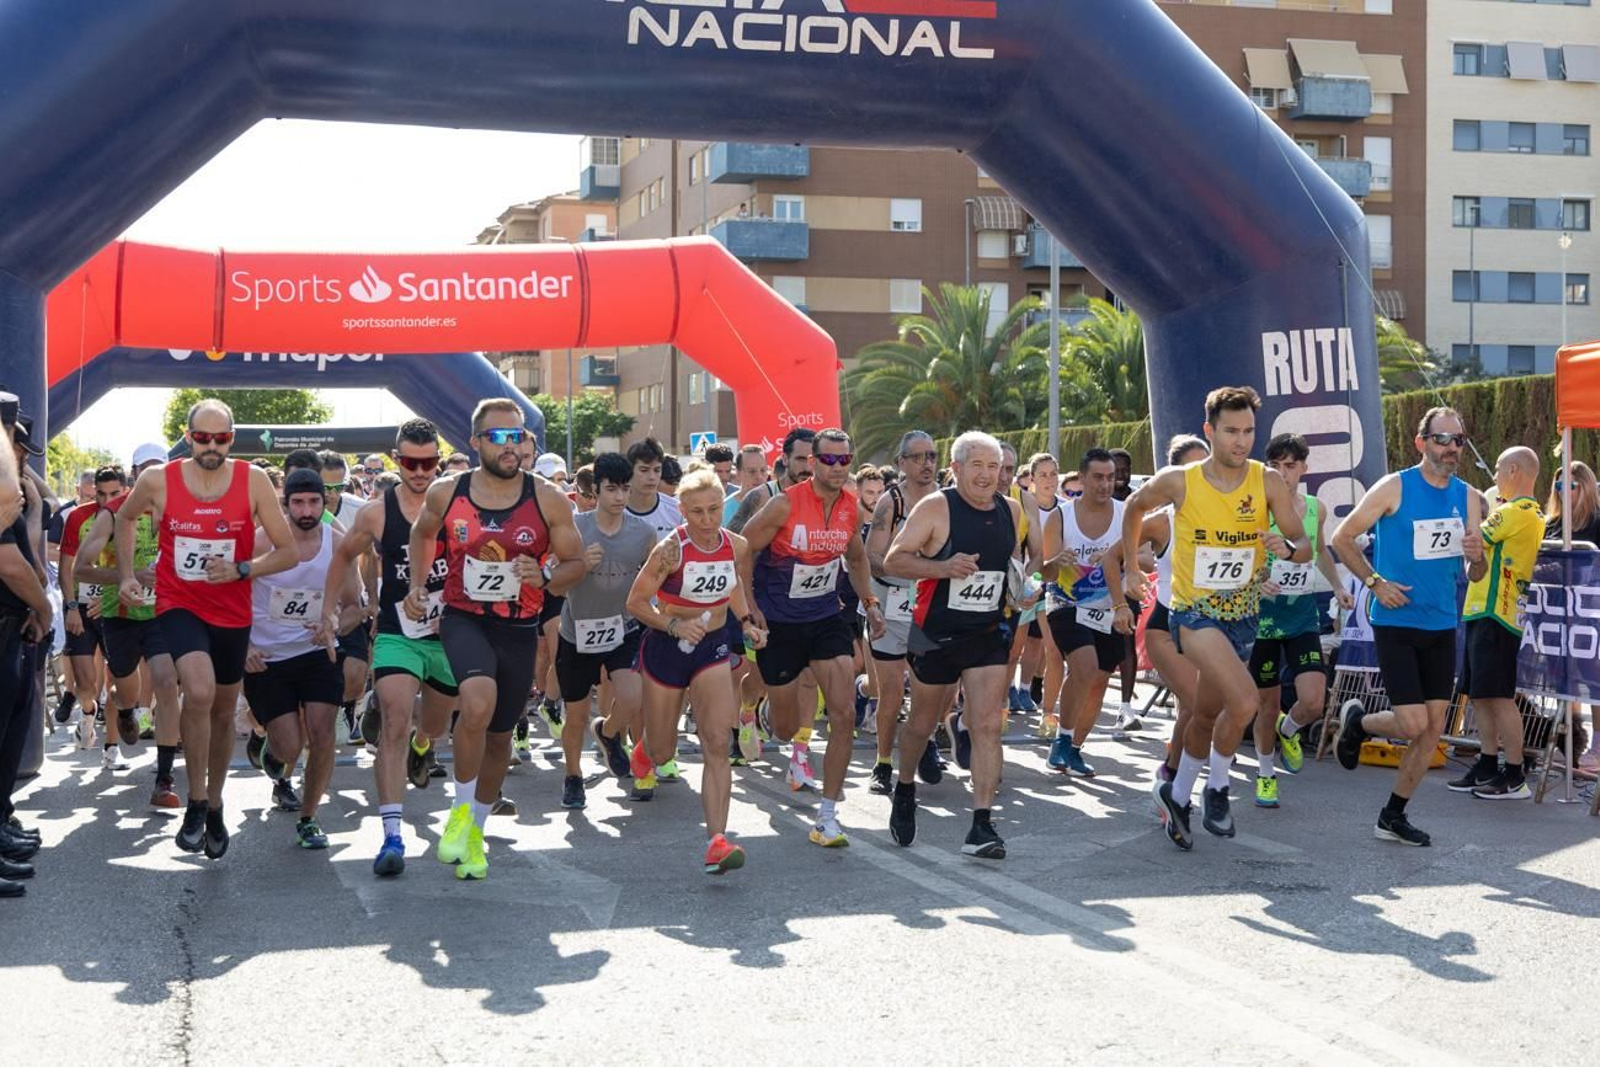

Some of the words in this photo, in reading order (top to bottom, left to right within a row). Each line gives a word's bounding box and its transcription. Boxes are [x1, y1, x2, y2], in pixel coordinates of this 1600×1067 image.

[627, 6, 995, 59] NACIONAL
[231, 271, 342, 311] Sports
[398, 270, 573, 302] Santander
[342, 315, 457, 330] sportssantander.es
[1262, 327, 1360, 396] RUTA
[778, 412, 824, 429] Sports
[1431, 531, 1452, 549] 73
[184, 552, 225, 570] 51
[394, 558, 449, 580] KAB
[1207, 561, 1244, 579] 176
[477, 574, 505, 591] 72
[691, 575, 727, 593] 249
[800, 572, 832, 589] 421
[1279, 571, 1308, 587] 351
[959, 583, 995, 601] 444
[283, 601, 308, 616] 84
[585, 628, 616, 645] 272
[1519, 620, 1600, 660] ACIO
